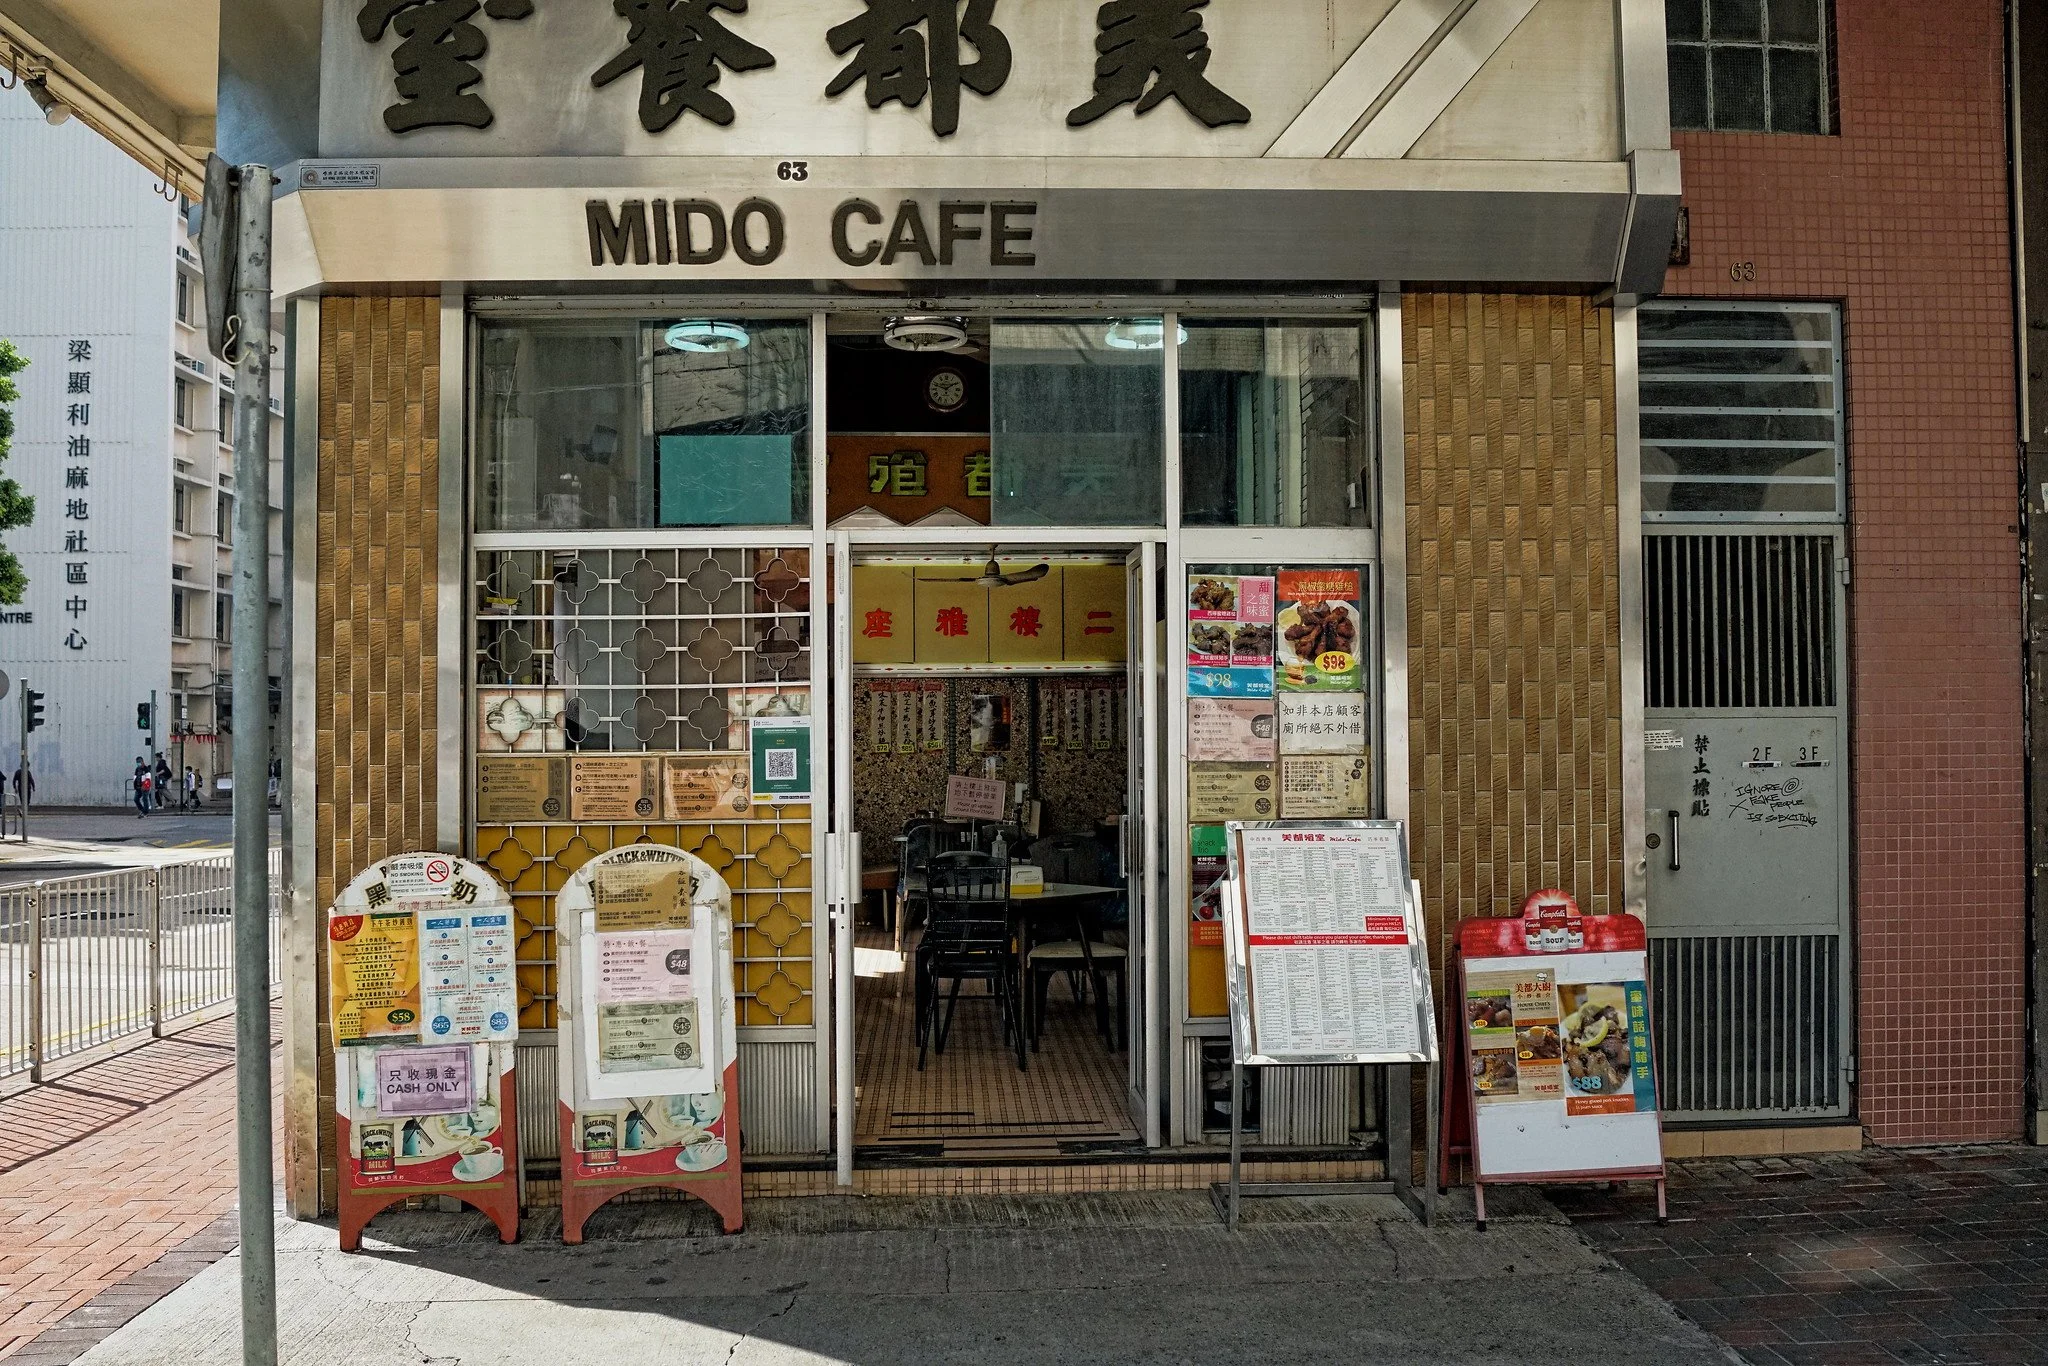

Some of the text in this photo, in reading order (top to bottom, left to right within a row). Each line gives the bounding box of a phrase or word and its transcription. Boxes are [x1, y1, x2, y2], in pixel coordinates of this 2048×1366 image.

[776, 160, 808, 182] 63
[586, 197, 1037, 268] MIDO CAFE
[1730, 261, 1756, 283] 63
[64, 339, 91, 652] 梁顯利油麻地社區中心
[1323, 653, 1346, 672] $98
[1205, 672, 1233, 688] $98
[1283, 704, 1361, 717] 如非本店顧客
[1282, 722, 1361, 735] 廁所絕不外借
[1691, 734, 1711, 817] 禁止標貼
[1735, 783, 1782, 798] IGNORE
[545, 803, 559, 811] $35
[637, 803, 652, 811] $35
[1769, 799, 1805, 812] PEOPLE
[670, 959, 688, 969] $48
[391, 1013, 411, 1024] $58
[674, 1022, 691, 1030] $45
[390, 1066, 457, 1082] 只收現金
[386, 1081, 461, 1095] CASH ONLY
[1572, 1075, 1602, 1091] $88
[591, 1151, 611, 1159] MILK
[369, 1161, 387, 1169] MILK
